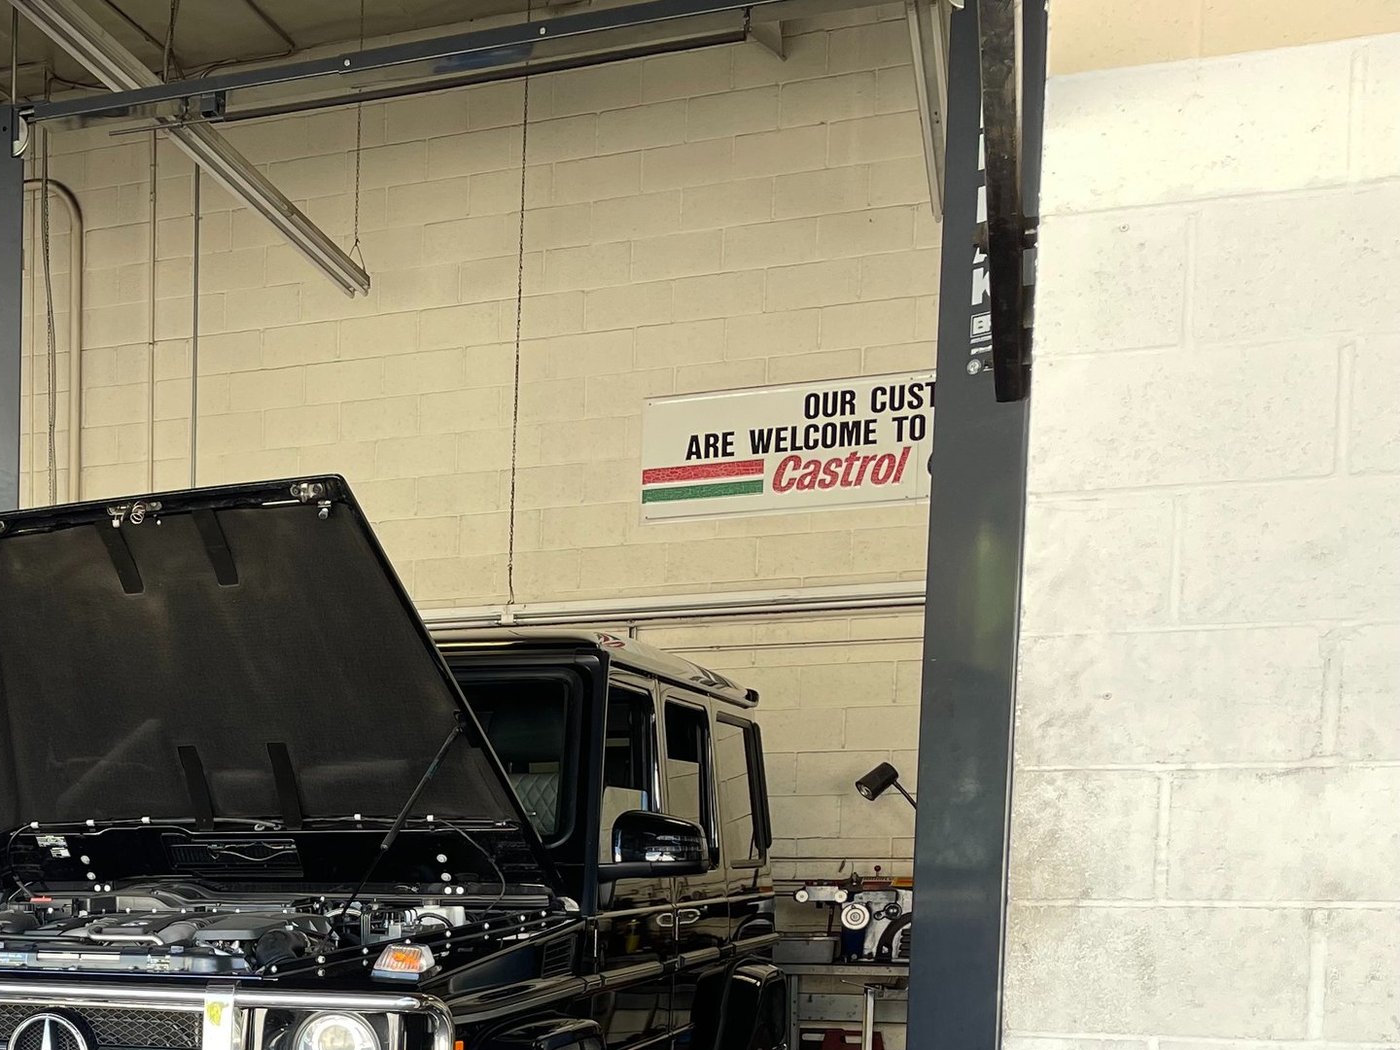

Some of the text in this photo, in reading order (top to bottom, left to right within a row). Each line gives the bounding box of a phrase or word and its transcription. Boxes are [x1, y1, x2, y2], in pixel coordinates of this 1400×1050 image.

[804, 382, 936, 420] OUR CUST
[685, 414, 926, 461] ARE WELCOME TO
[771, 446, 913, 494] Castrol
